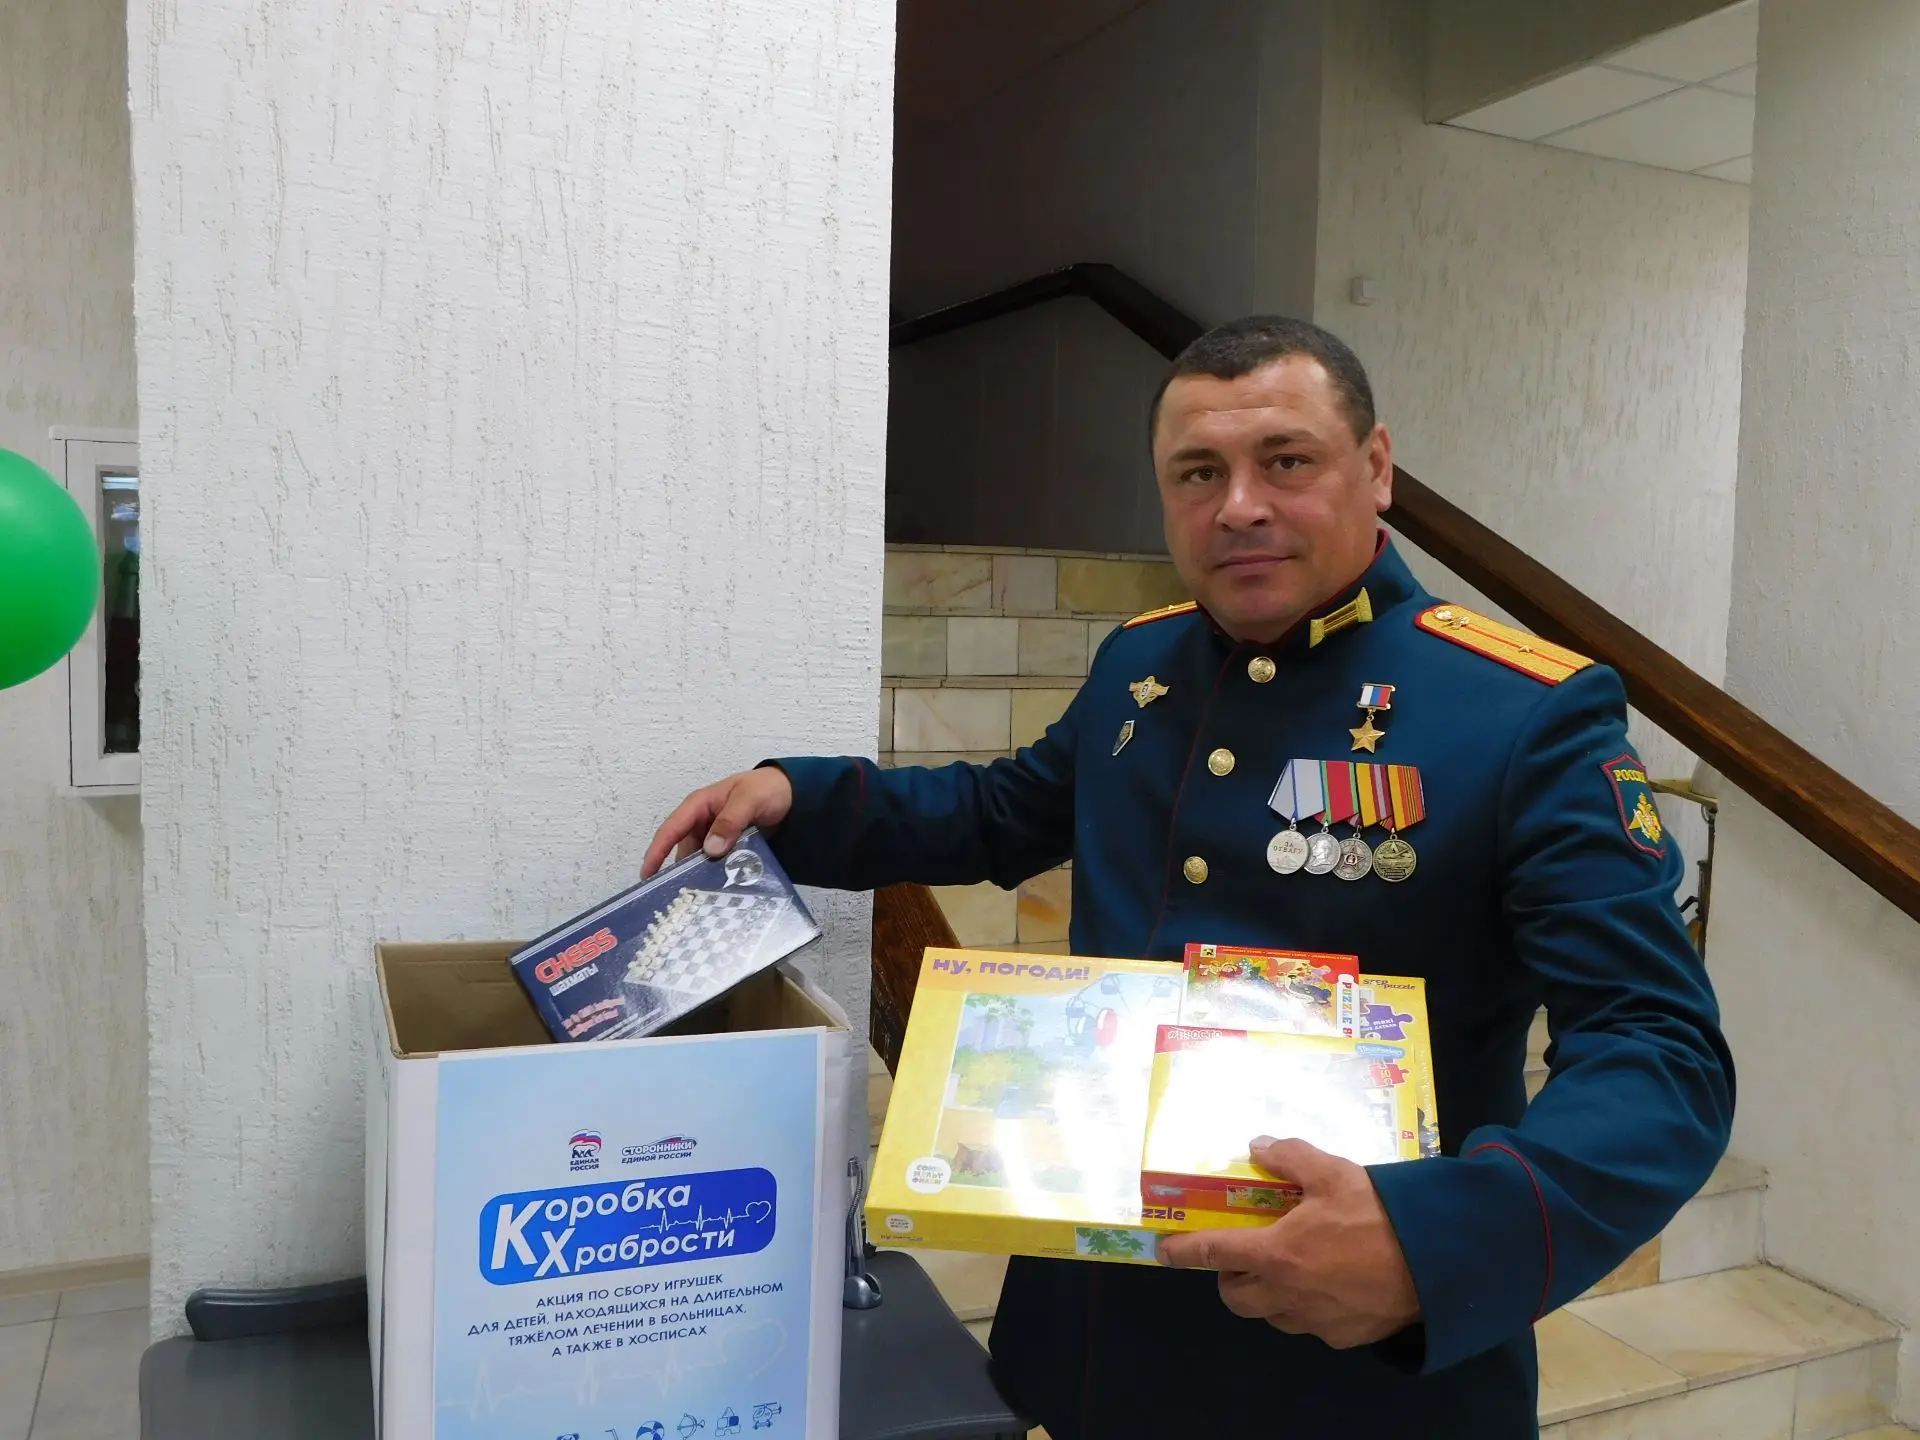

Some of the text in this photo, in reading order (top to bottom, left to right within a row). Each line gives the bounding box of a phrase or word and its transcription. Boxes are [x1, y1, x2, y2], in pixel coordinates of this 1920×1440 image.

[535, 927, 618, 984] CHESS
[1342, 981, 1353, 1025] PUZZLE
[570, 1158, 600, 1166] ЕДИНАЯ
[621, 1151, 692, 1164] ЕДИНОЙ РОССИИ
[622, 1141, 693, 1157] СТОРОННИКИ
[570, 1163, 600, 1172] РОССИЯ
[490, 1182, 692, 1270] Коробка
[1138, 1206, 1186, 1221] zzle
[533, 1227, 735, 1278] Храбрости
[536, 1274, 724, 1308] АКЦИЯ ПО СБОРУ ИГРУШЕК
[467, 1282, 784, 1336] ДЛЯ ДЕТЕЙ, НАХОДЯЩИХСЯ НА ДЛИТЕЛЬНОМ
[508, 1303, 747, 1347] ТЯЖЁЛОМ ЛЕЧЕНИИ В БОЛЬНИЦАХ,
[551, 1325, 708, 1358] А ТАКЖЕ В ХОСПИСАХ
